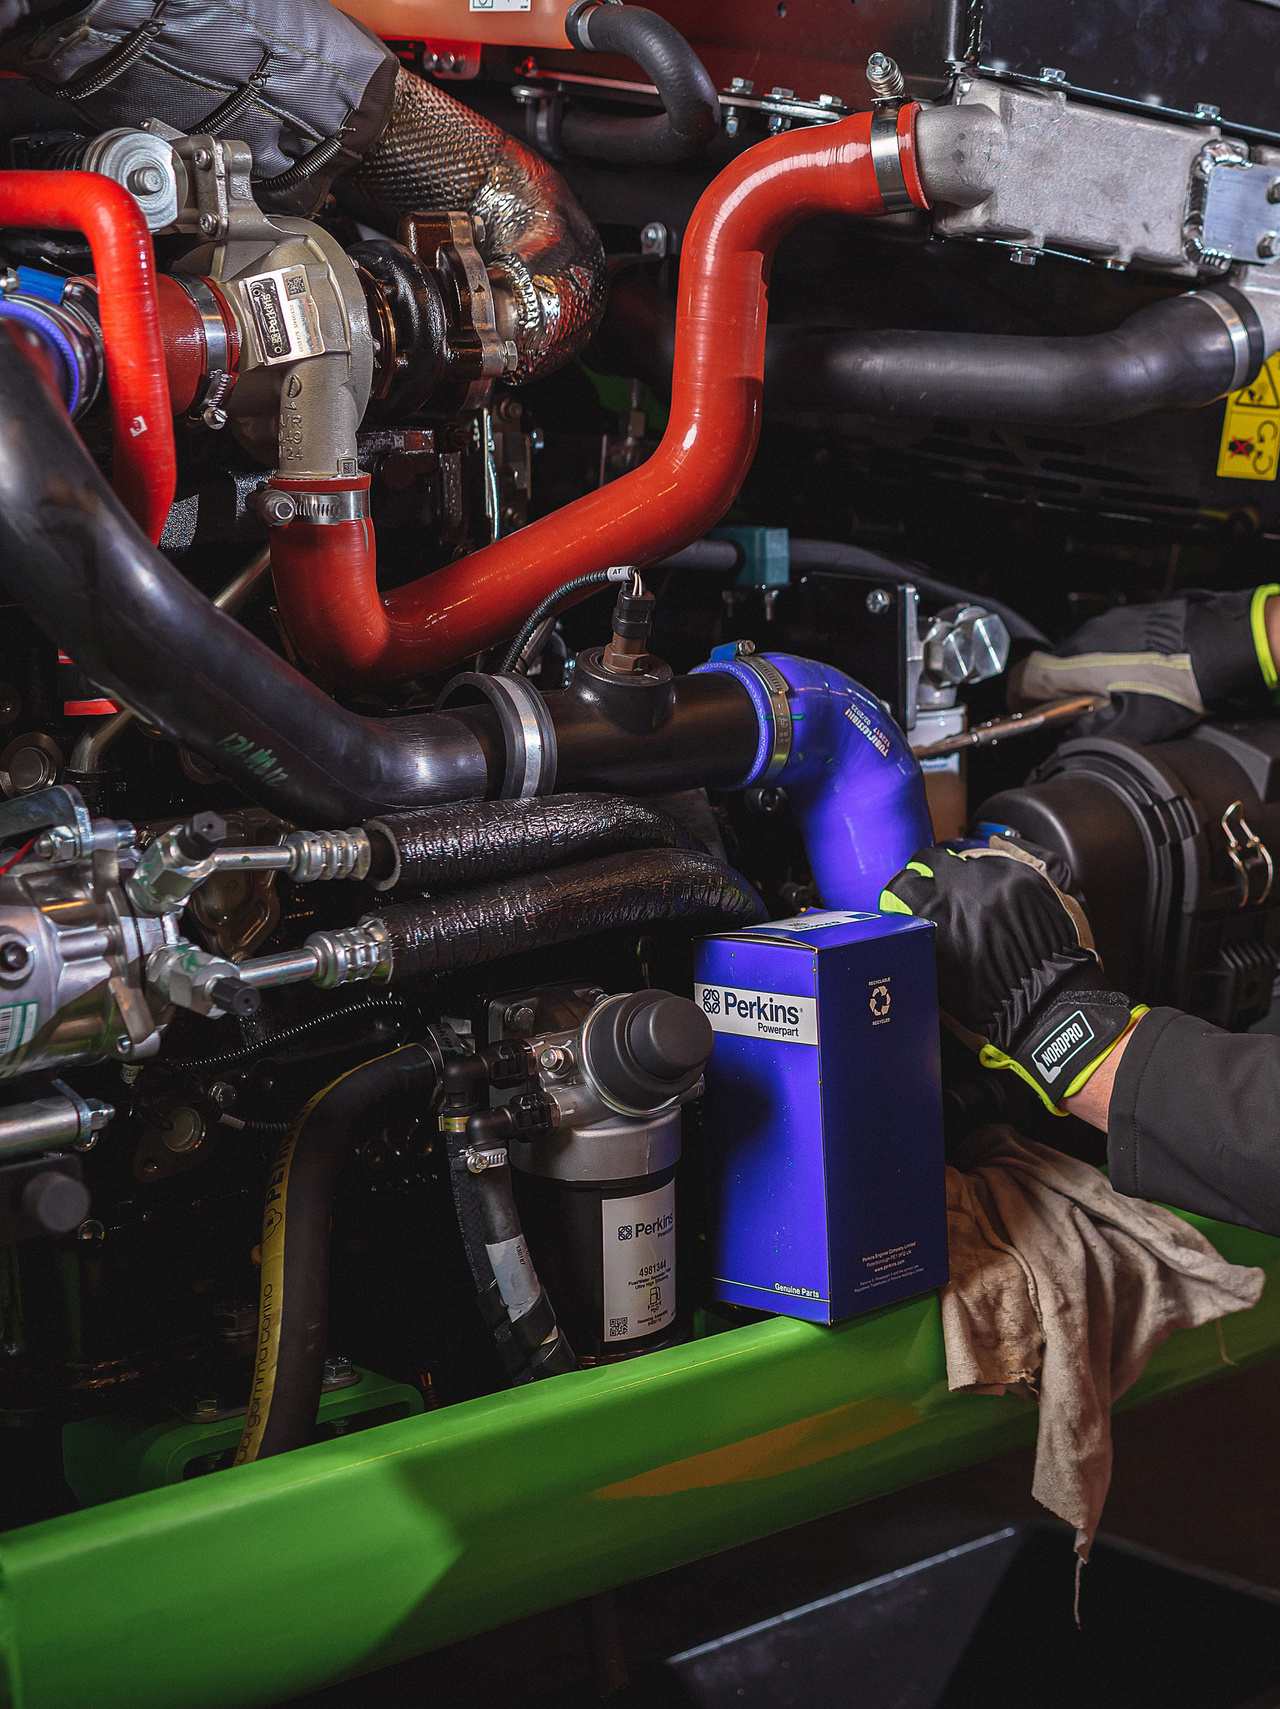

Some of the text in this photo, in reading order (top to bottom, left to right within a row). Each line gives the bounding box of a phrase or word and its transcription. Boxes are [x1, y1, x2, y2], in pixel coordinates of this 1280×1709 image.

[263, 293, 279, 333] Perkins
[724, 991, 800, 1025] Perkins
[757, 1022, 800, 1037] Powerpart
[1041, 1022, 1084, 1067] NORDPRO
[635, 1213, 674, 1238] Perkins
[639, 1258, 667, 1277] 4981344
[774, 1282, 820, 1299] Genuine Parts
[246, 1347, 268, 1429] gomma
[259, 1283, 273, 1346] torino
